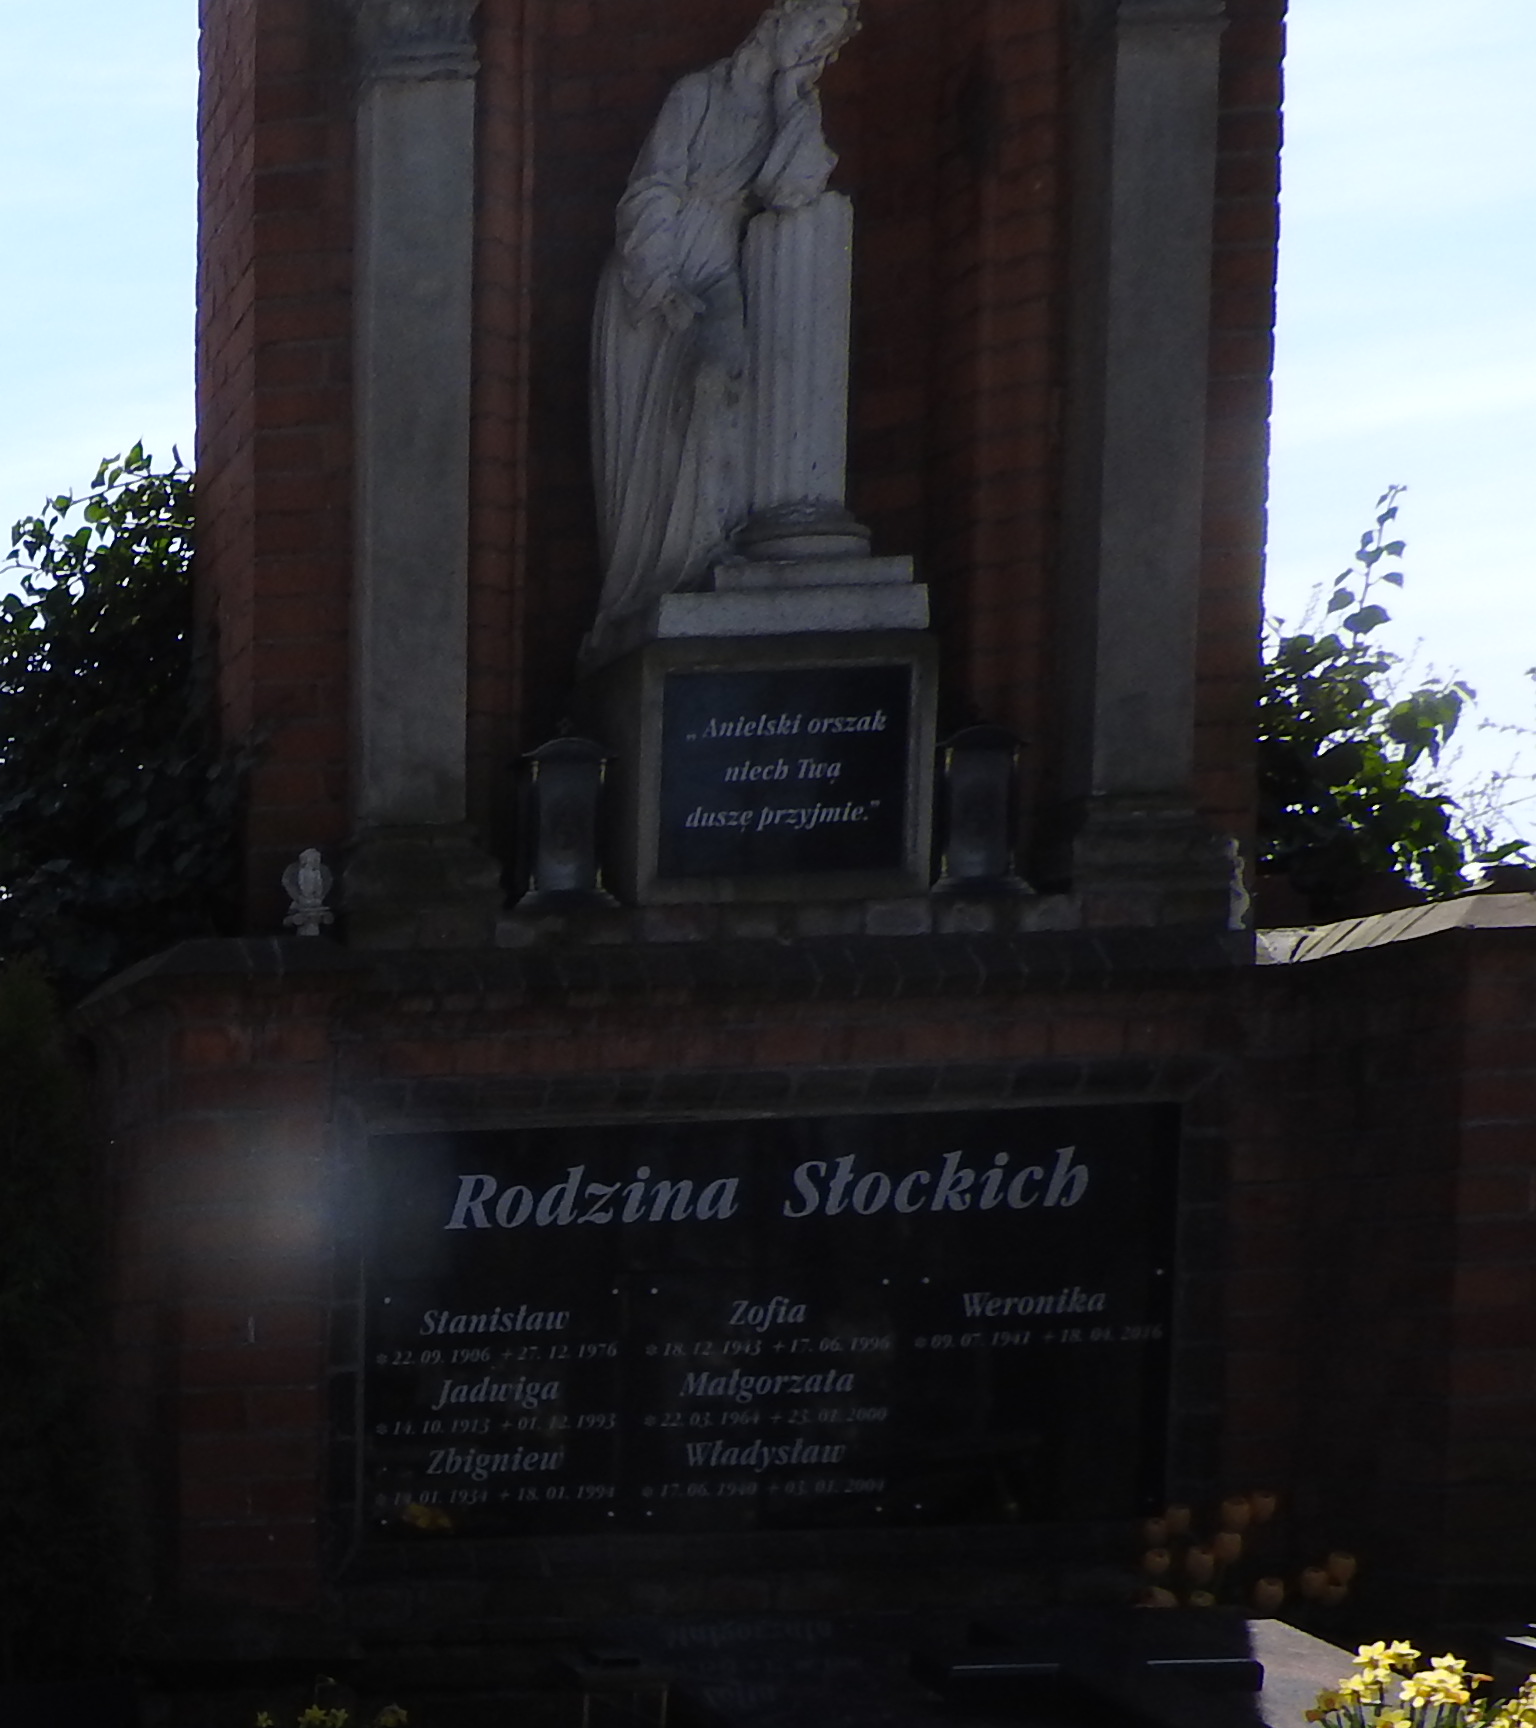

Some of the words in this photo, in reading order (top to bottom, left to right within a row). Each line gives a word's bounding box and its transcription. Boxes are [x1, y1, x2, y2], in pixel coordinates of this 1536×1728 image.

[807, 709, 887, 734] orszak
[724, 758, 789, 782] niech
[797, 758, 842, 784] Twą
[685, 806, 753, 833] duszę
[444, 1165, 740, 1230] Rodzina
[782, 1146, 1090, 1218] Słockich
[729, 1295, 807, 1332] Zofia
[962, 1286, 1107, 1318] Weronika
[419, 1304, 571, 1335] Stanisław
[451, 1347, 491, 1363] 1906
[578, 1341, 618, 1359] 1976
[850, 1335, 891, 1351] 1996
[431, 1376, 560, 1411] Jadwiga
[679, 1368, 855, 1403] Małgorzata
[577, 1412, 617, 1429] 1993
[426, 1445, 566, 1481] Zbigniew
[686, 1438, 847, 1473] Władysław
